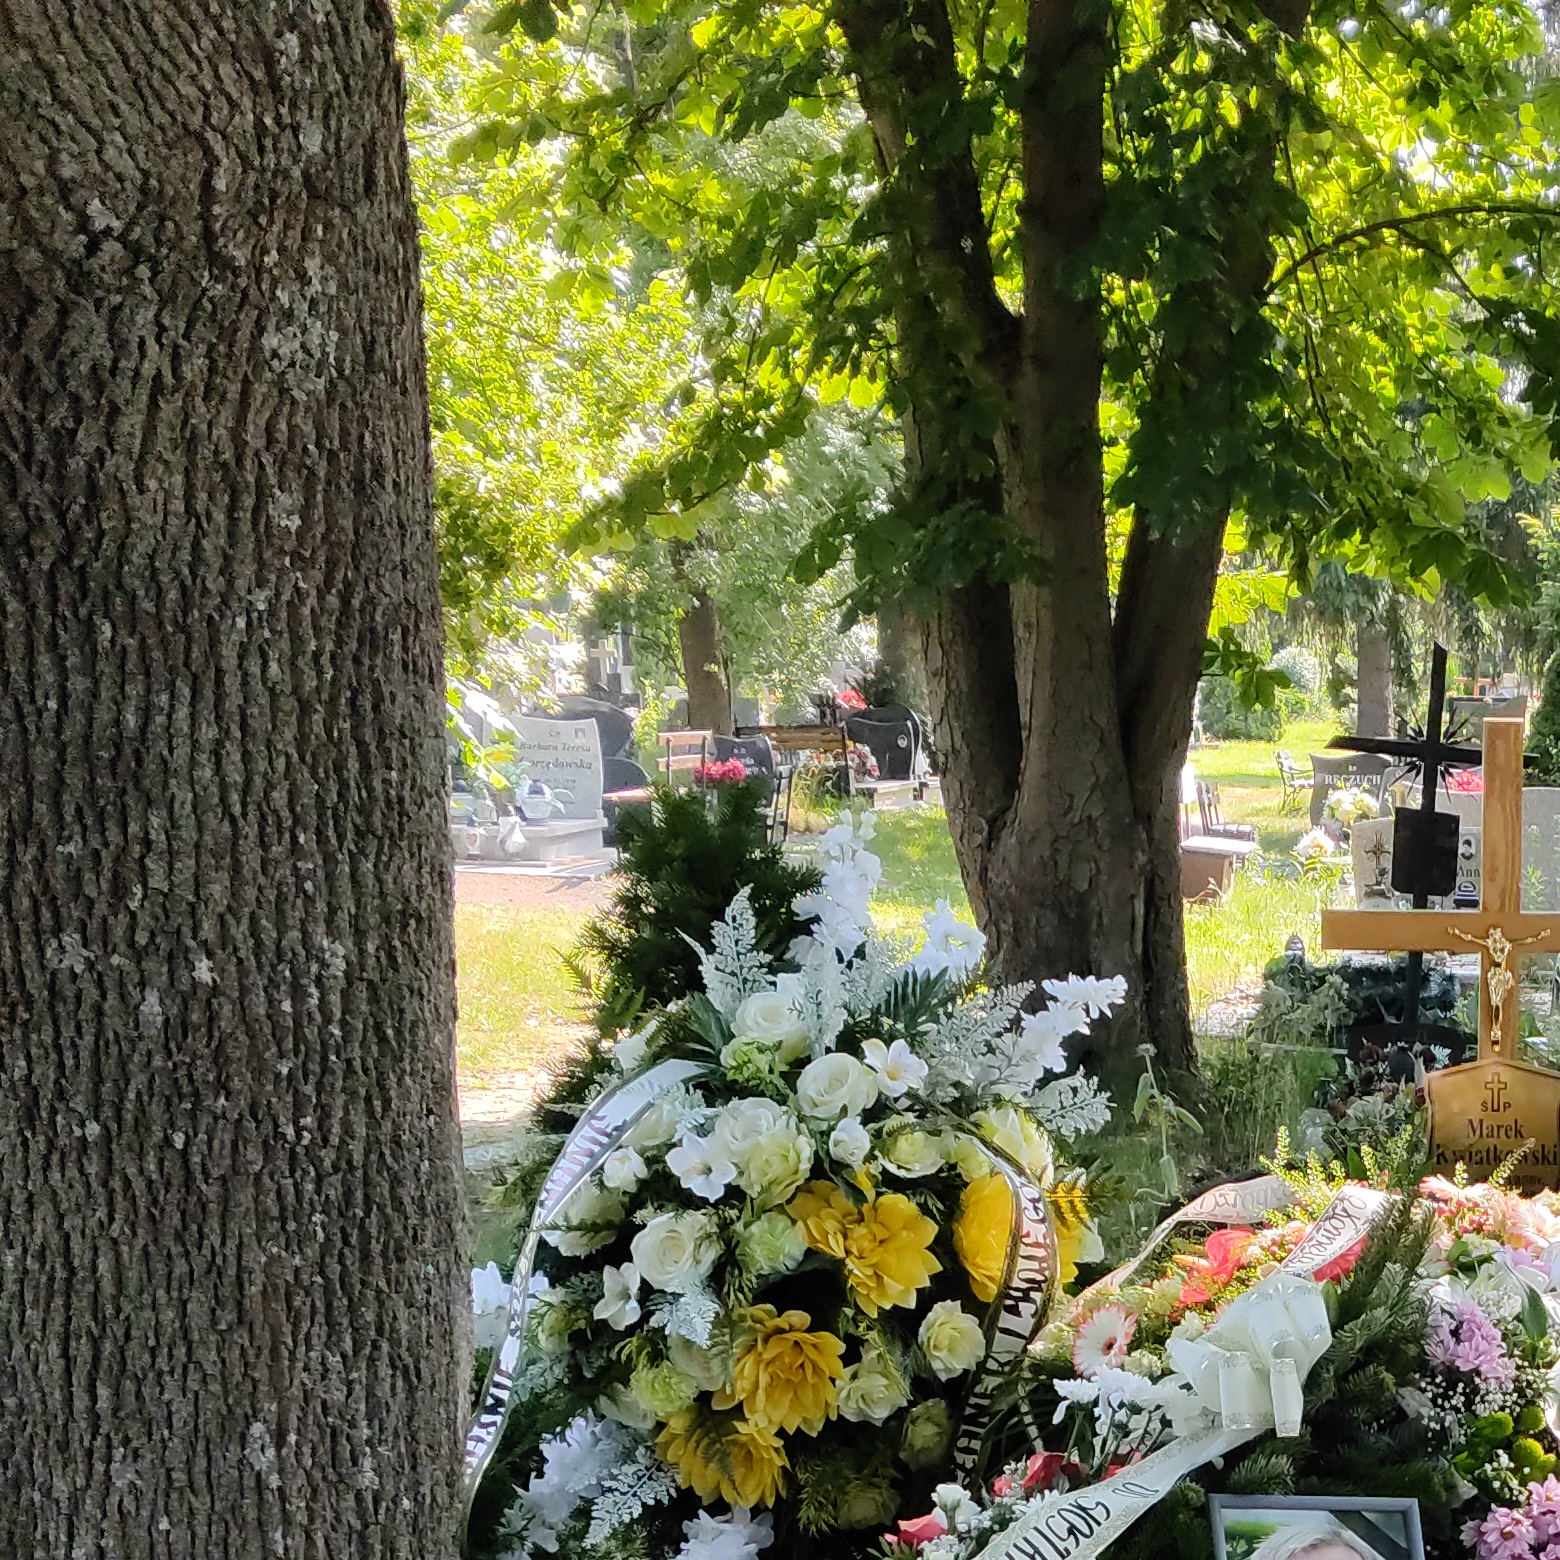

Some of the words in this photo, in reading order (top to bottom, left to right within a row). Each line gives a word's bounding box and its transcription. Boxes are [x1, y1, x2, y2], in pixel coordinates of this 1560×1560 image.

[562, 743, 592, 753] Teresa
[520, 757, 593, 771] orzędowska
[1456, 866, 1481, 878] Ann
[1467, 1118, 1525, 1139] Marek
[1435, 1143, 1558, 1166] Kwiatkowski
